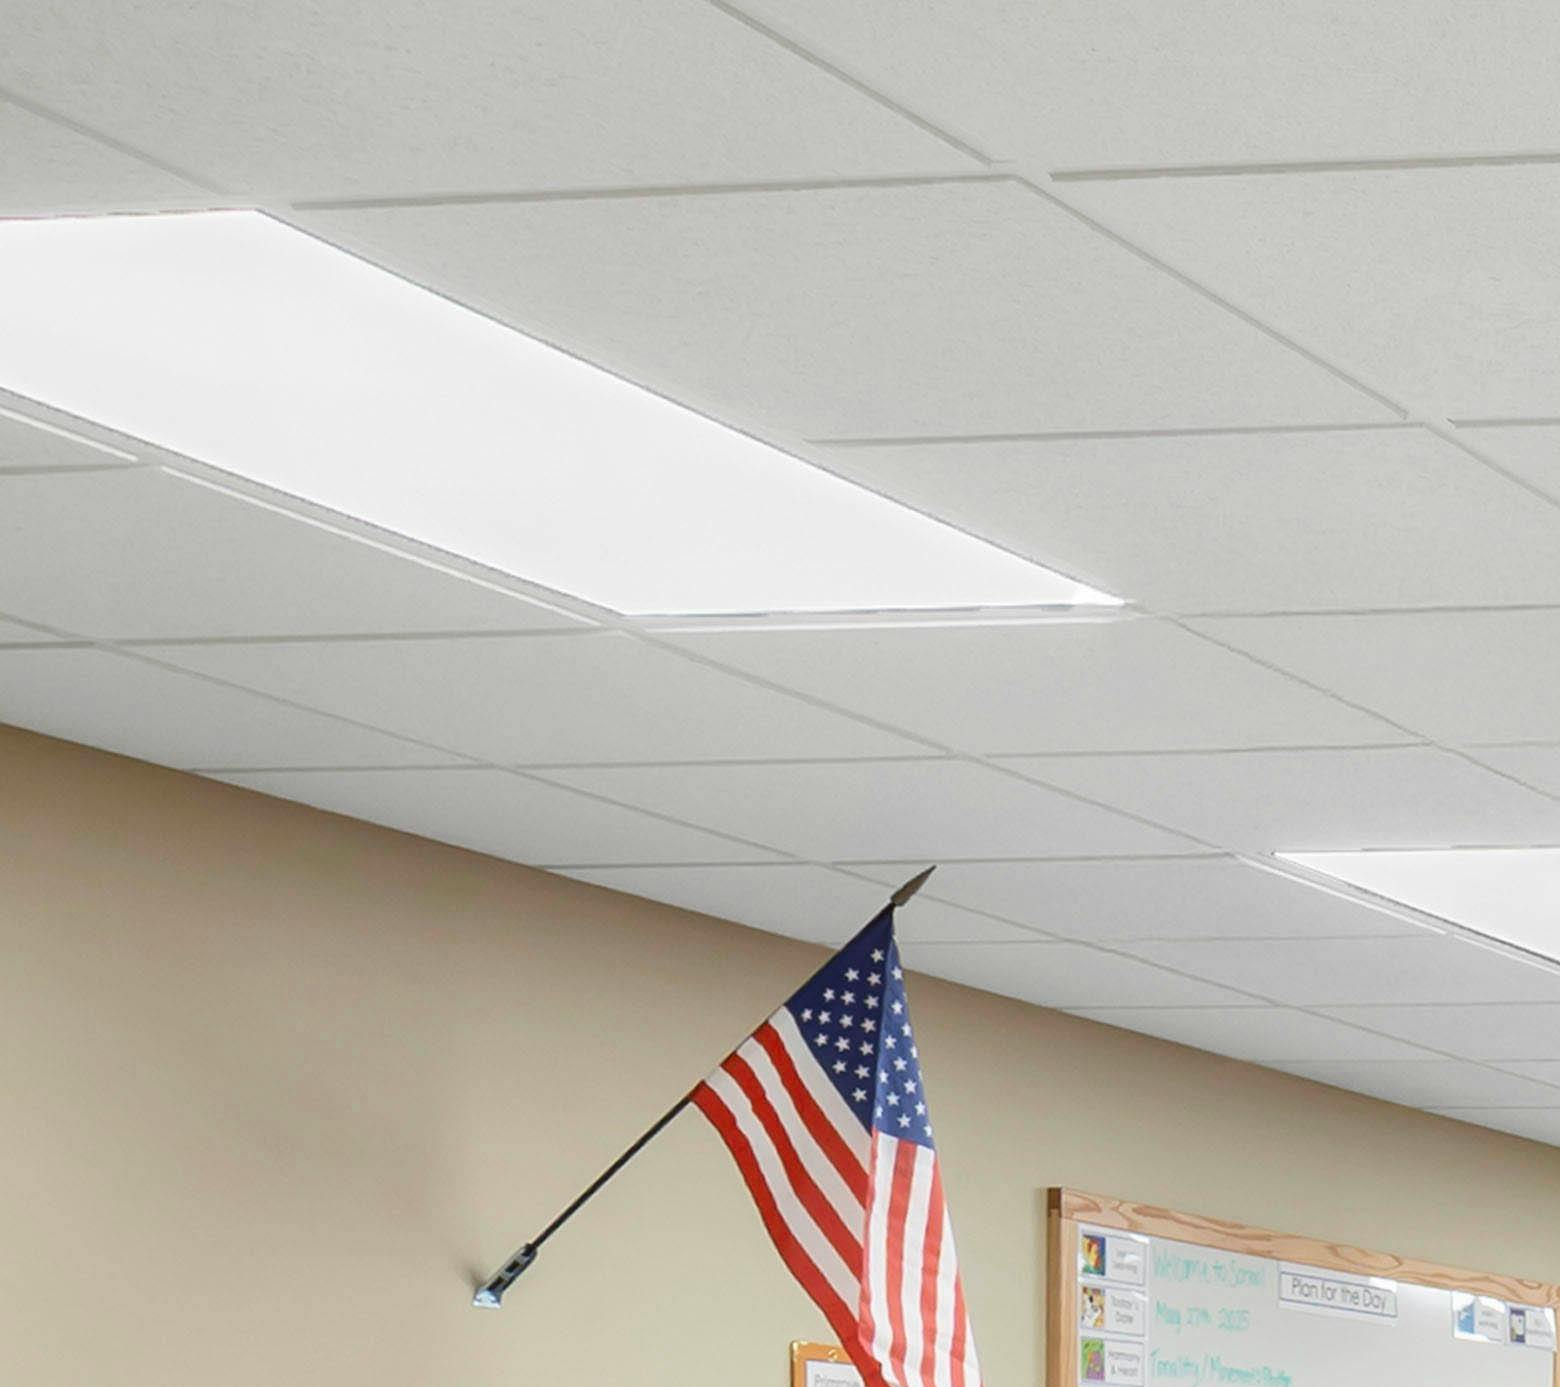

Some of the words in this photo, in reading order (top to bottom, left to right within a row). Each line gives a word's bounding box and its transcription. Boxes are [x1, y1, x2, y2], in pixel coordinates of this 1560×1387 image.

[1291, 1277, 1317, 1298] Plan
[1321, 1283, 1338, 1301] for
[1341, 1288, 1360, 1305] the
[1363, 1289, 1386, 1312] Day
